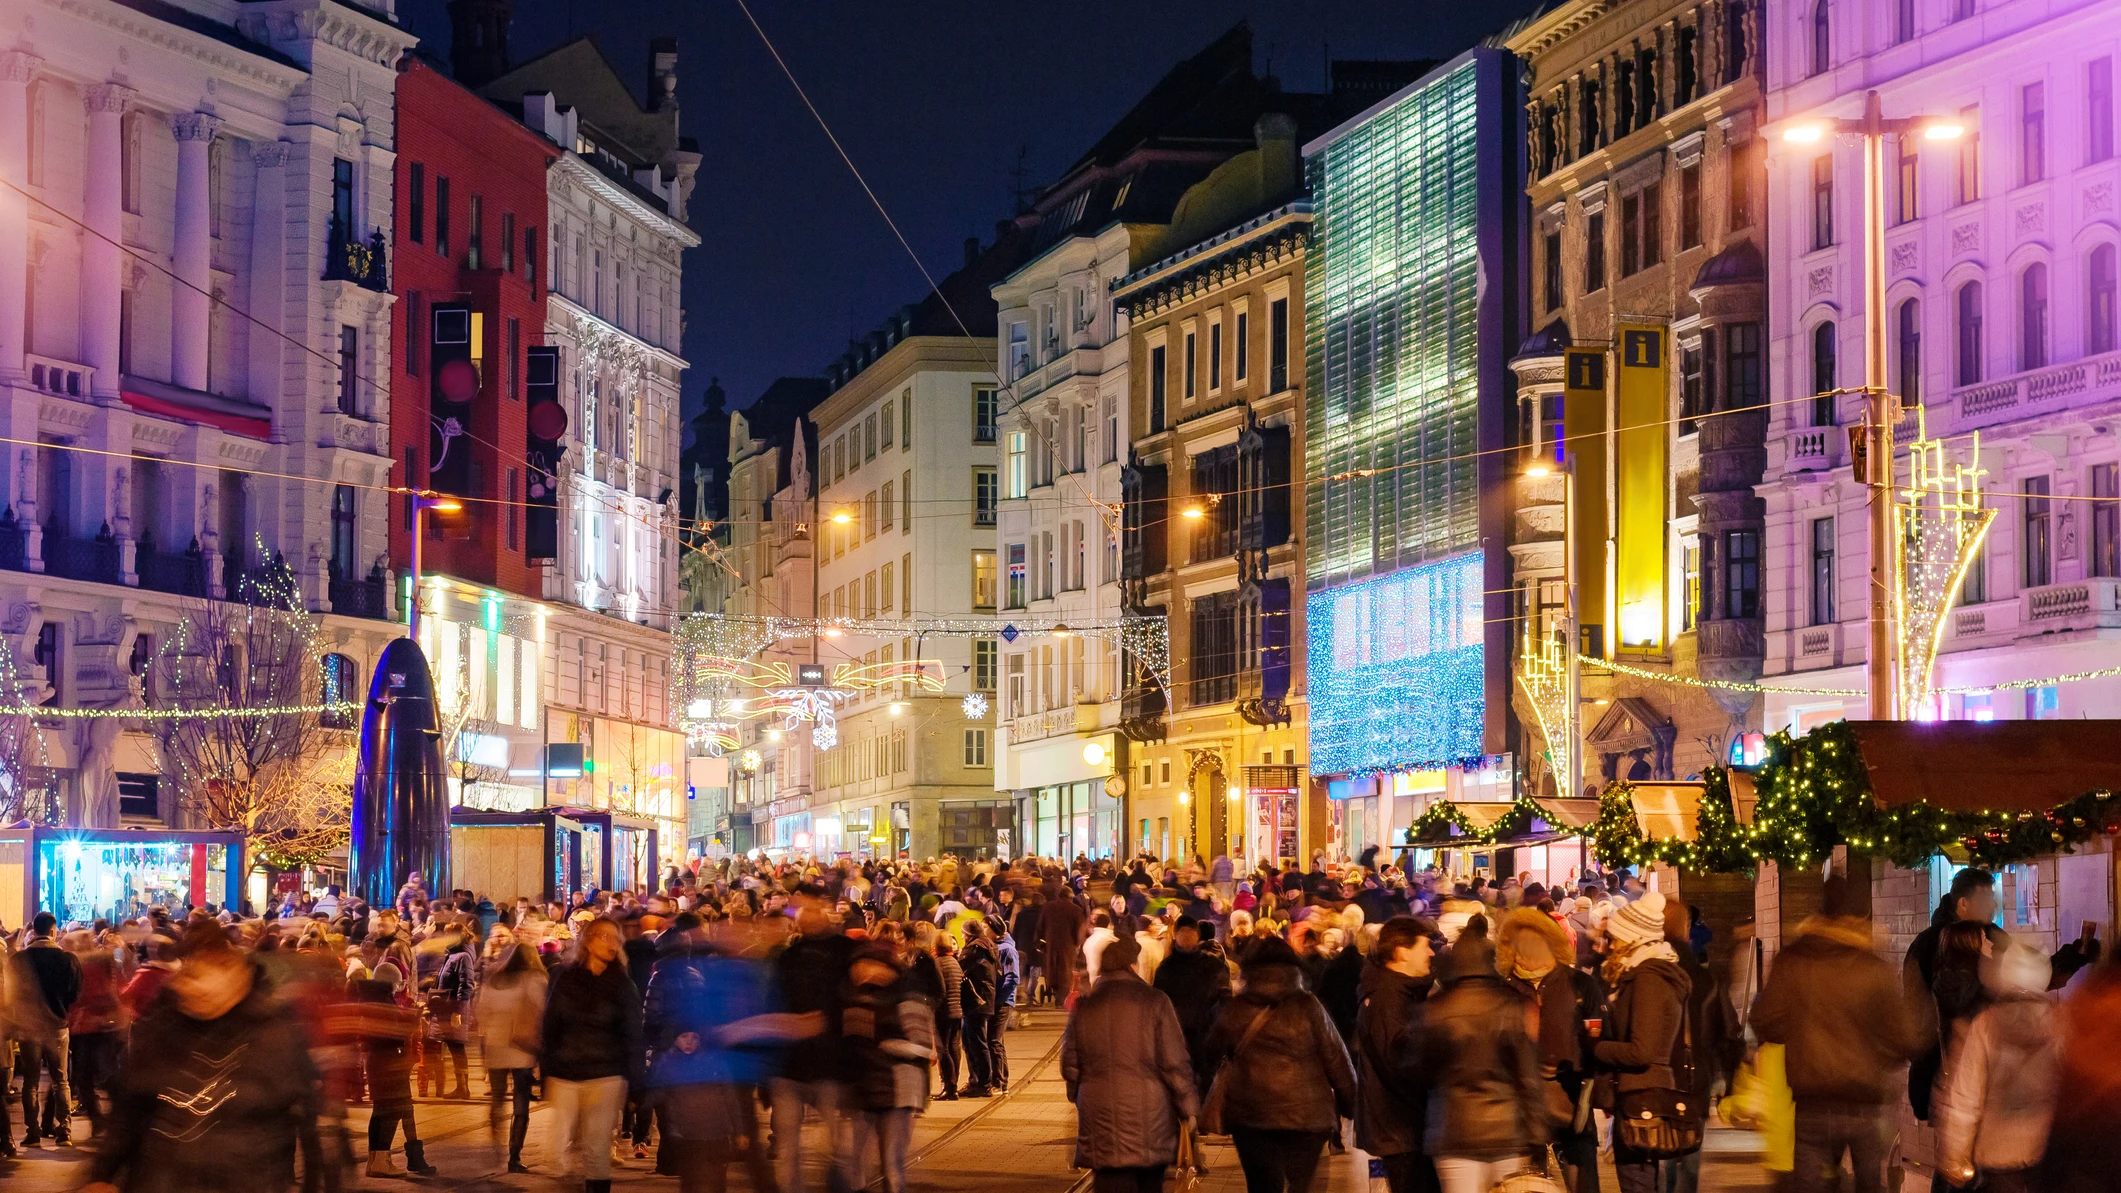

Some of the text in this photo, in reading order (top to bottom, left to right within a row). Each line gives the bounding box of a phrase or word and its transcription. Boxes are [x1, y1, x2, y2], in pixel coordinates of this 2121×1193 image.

[1637, 335, 1648, 363] i
[1580, 357, 1591, 386] i
[1580, 628, 1590, 655] i
